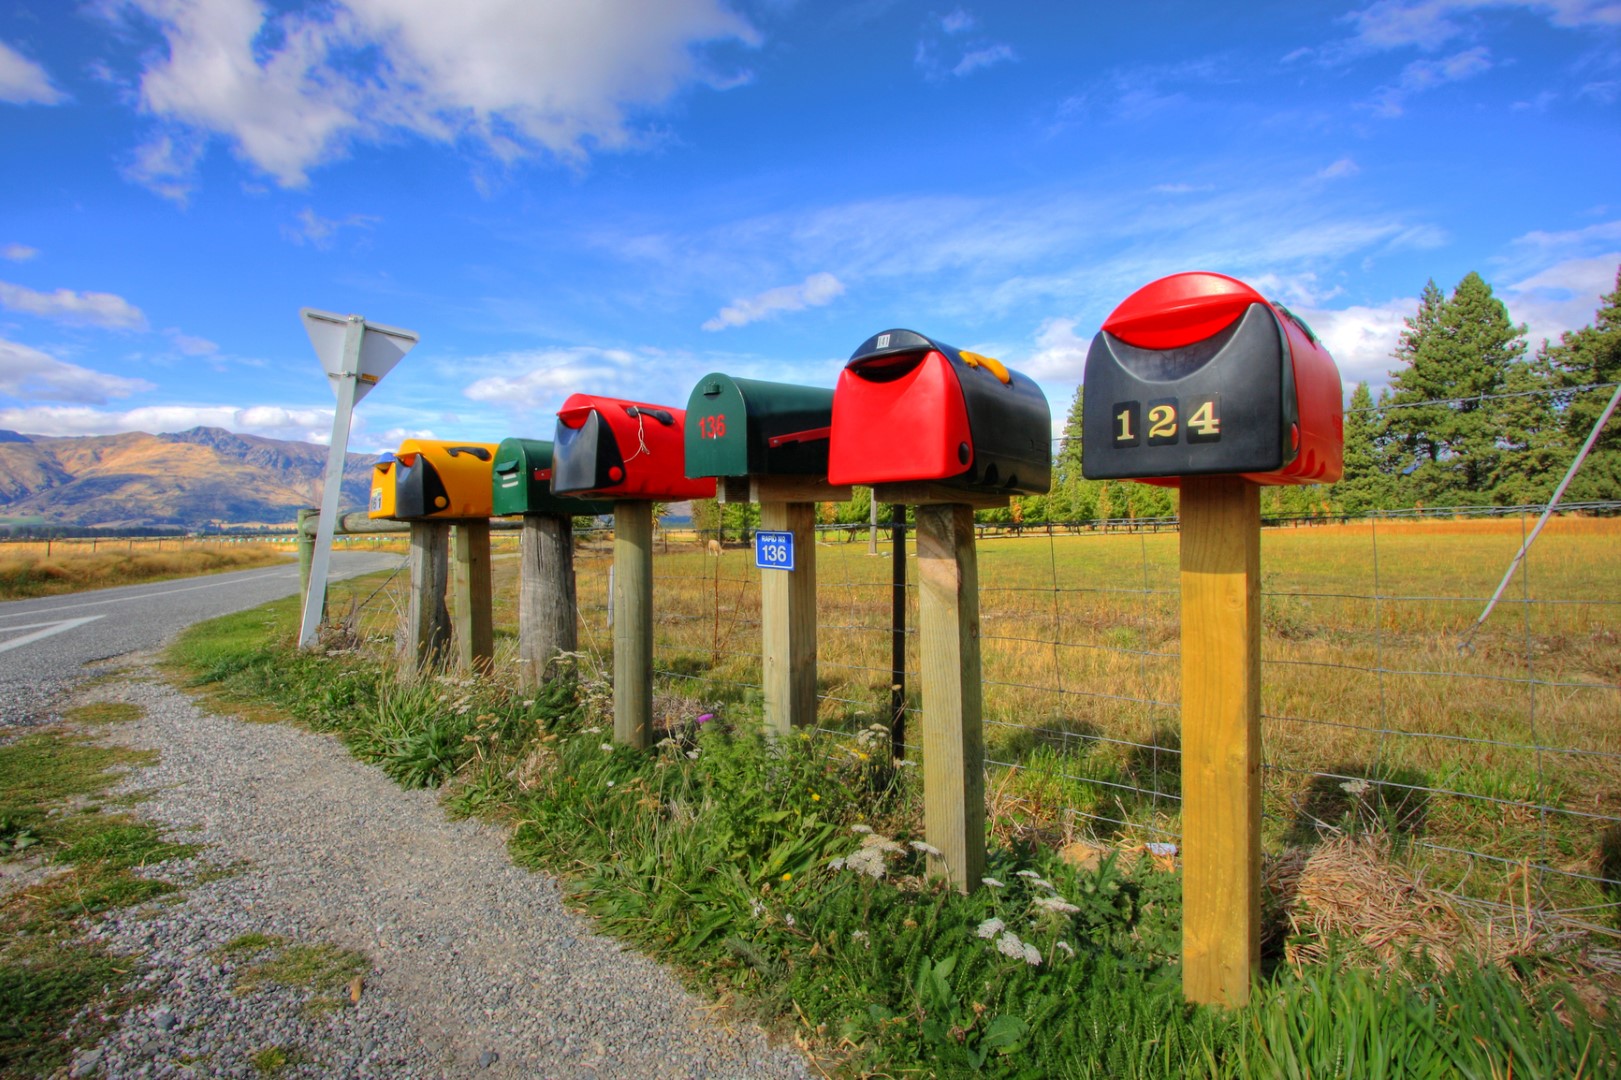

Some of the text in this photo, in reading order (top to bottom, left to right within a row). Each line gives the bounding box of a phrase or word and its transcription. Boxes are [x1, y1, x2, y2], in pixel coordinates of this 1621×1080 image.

[699, 414, 726, 439] 136
[1117, 401, 1220, 441] 124
[762, 545, 787, 562] 136
